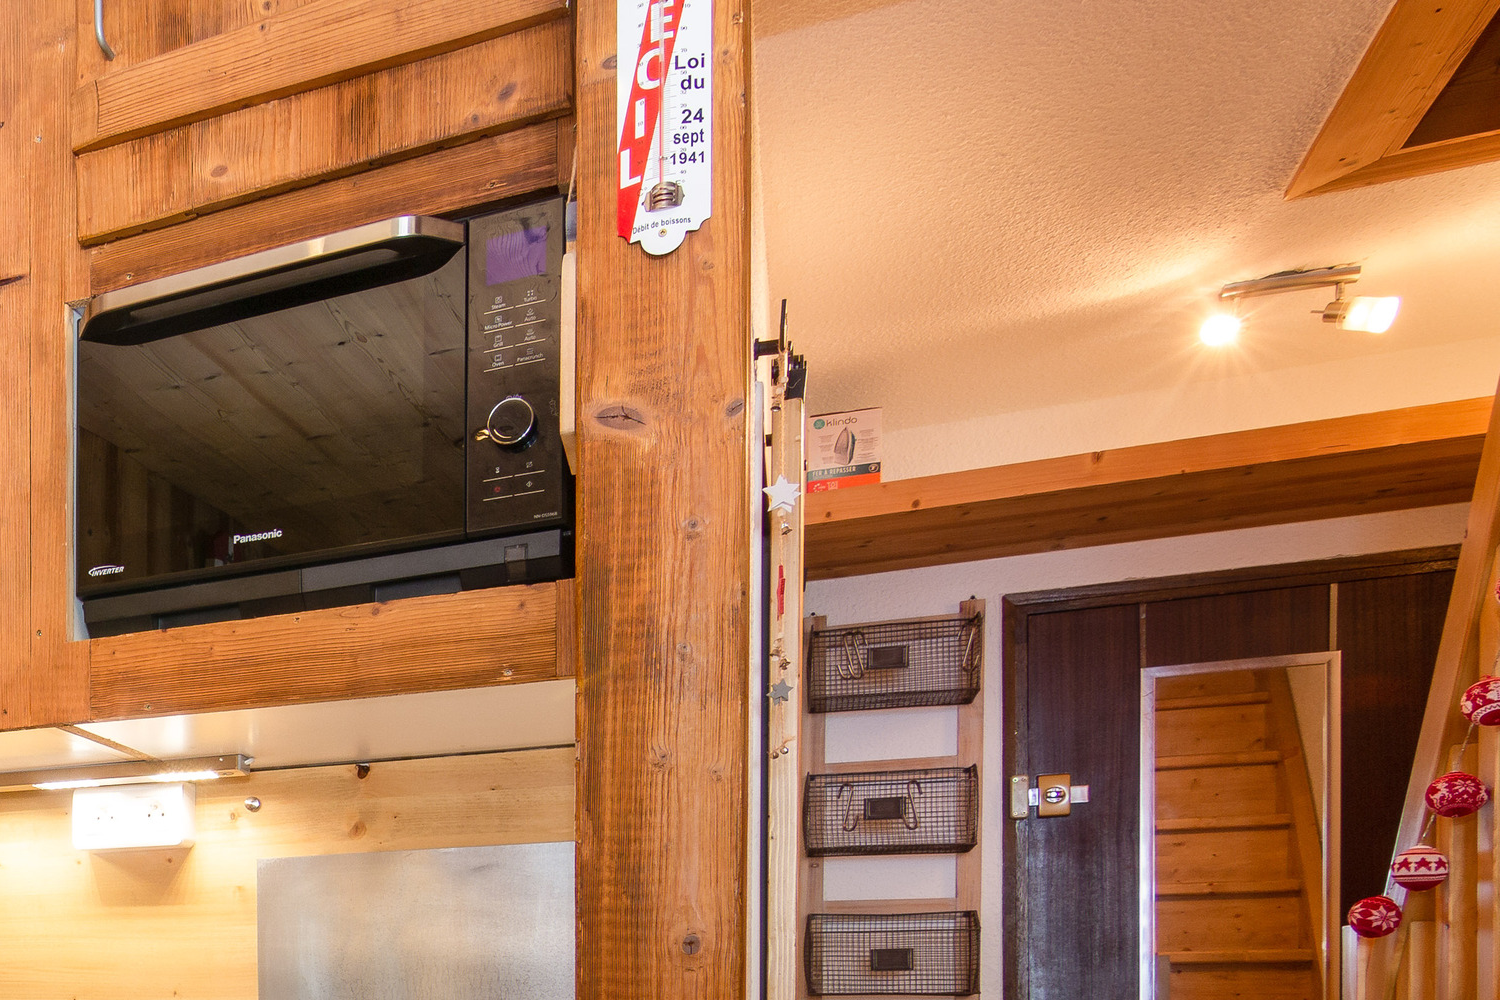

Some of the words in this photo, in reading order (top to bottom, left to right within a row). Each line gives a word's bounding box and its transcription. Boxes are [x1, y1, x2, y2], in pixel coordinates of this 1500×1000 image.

[674, 53, 705, 70] Loi
[680, 75, 705, 90] du
[681, 107, 705, 124] 24
[673, 128, 705, 147] sept
[669, 150, 705, 165] 1941
[650, 221, 659, 229] de
[660, 217, 691, 227] boissons
[826, 416, 858, 427] klindo
[233, 528, 283, 545] Panasonic
[91, 565, 125, 577] INVERTER
